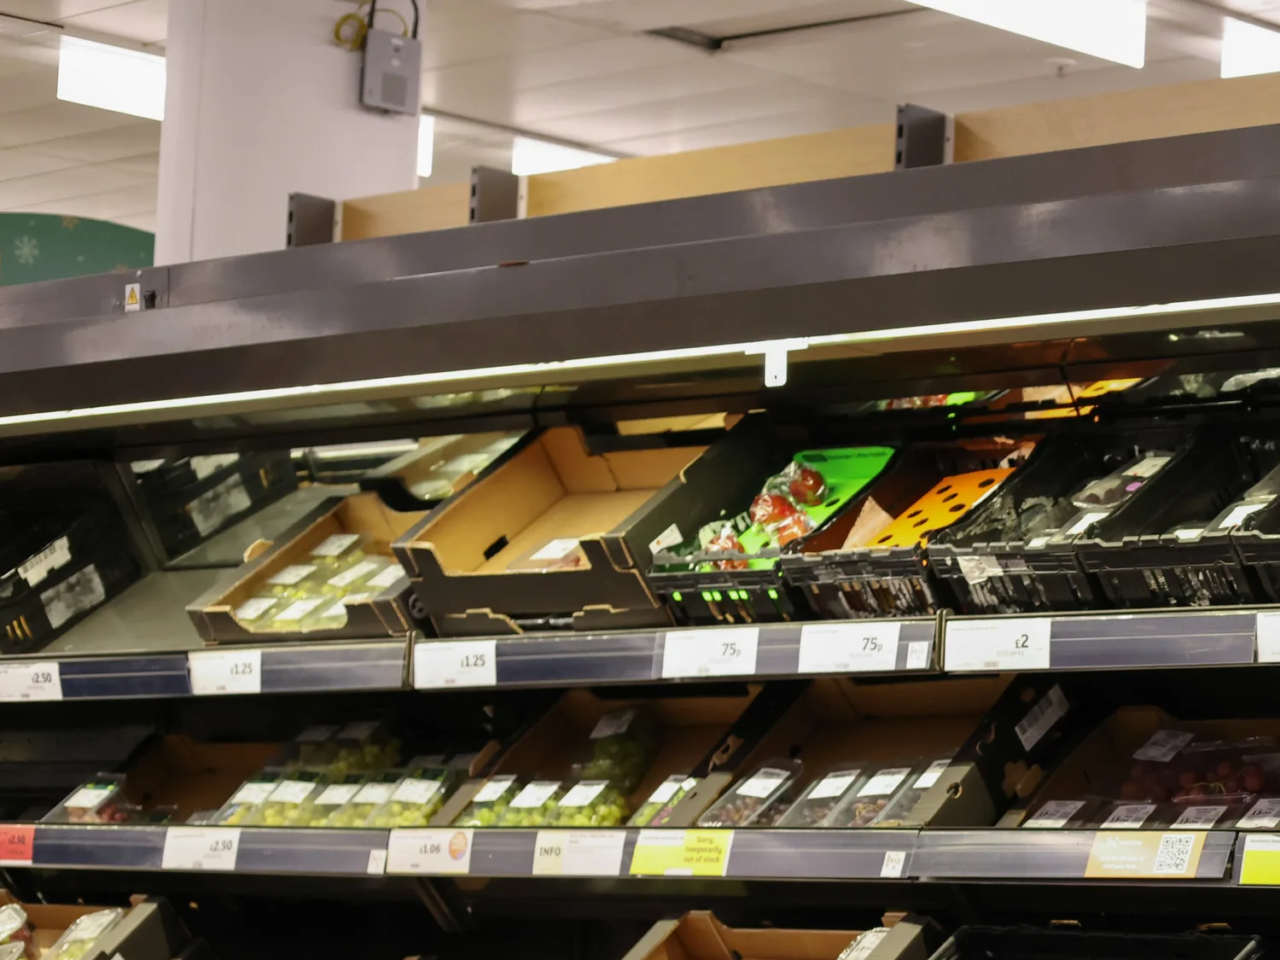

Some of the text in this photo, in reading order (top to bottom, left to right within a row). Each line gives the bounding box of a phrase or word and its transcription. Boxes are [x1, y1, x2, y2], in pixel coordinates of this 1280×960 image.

[861, 637, 883, 652] 75p
[1015, 633, 1029, 649] £2
[721, 642, 742, 657] 75p
[539, 846, 561, 857] INFO
